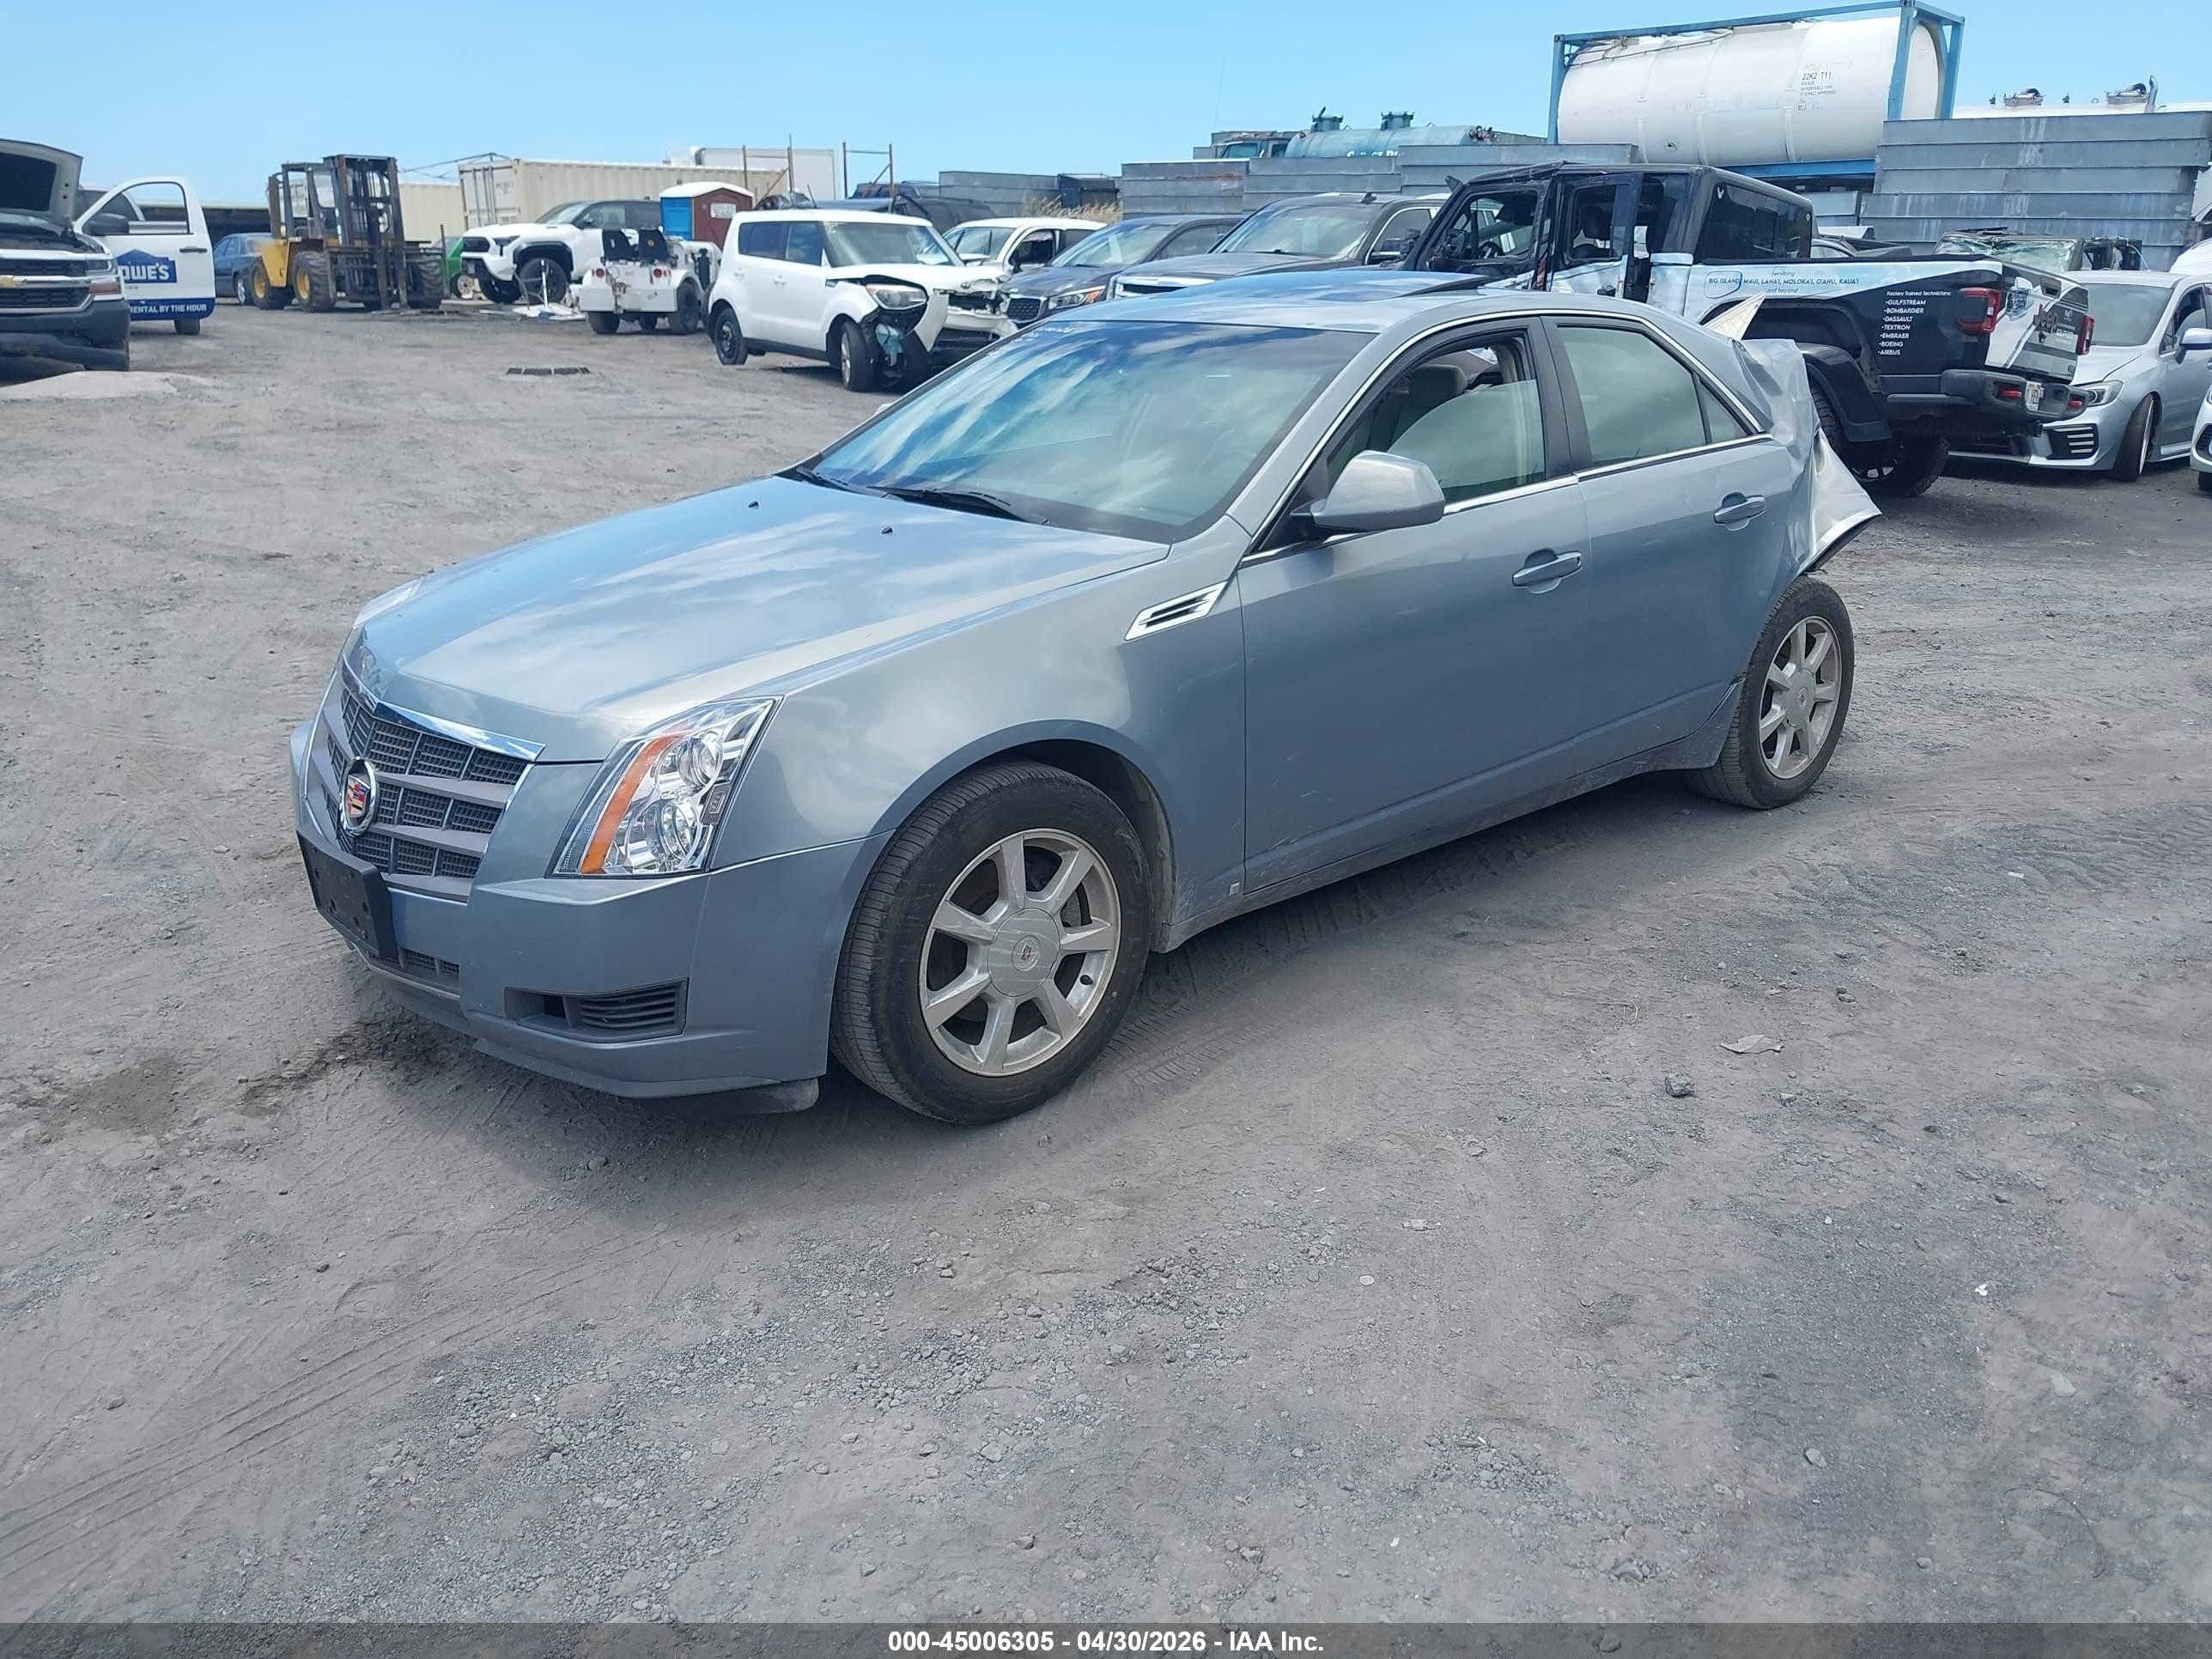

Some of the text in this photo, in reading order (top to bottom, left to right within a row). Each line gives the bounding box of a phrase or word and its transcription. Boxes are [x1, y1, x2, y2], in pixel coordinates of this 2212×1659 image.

[118, 262, 170, 281] OWE'S
[131, 303, 207, 314] RENTAL BY THE HOUR
[2033, 303, 2058, 334] Jeep
